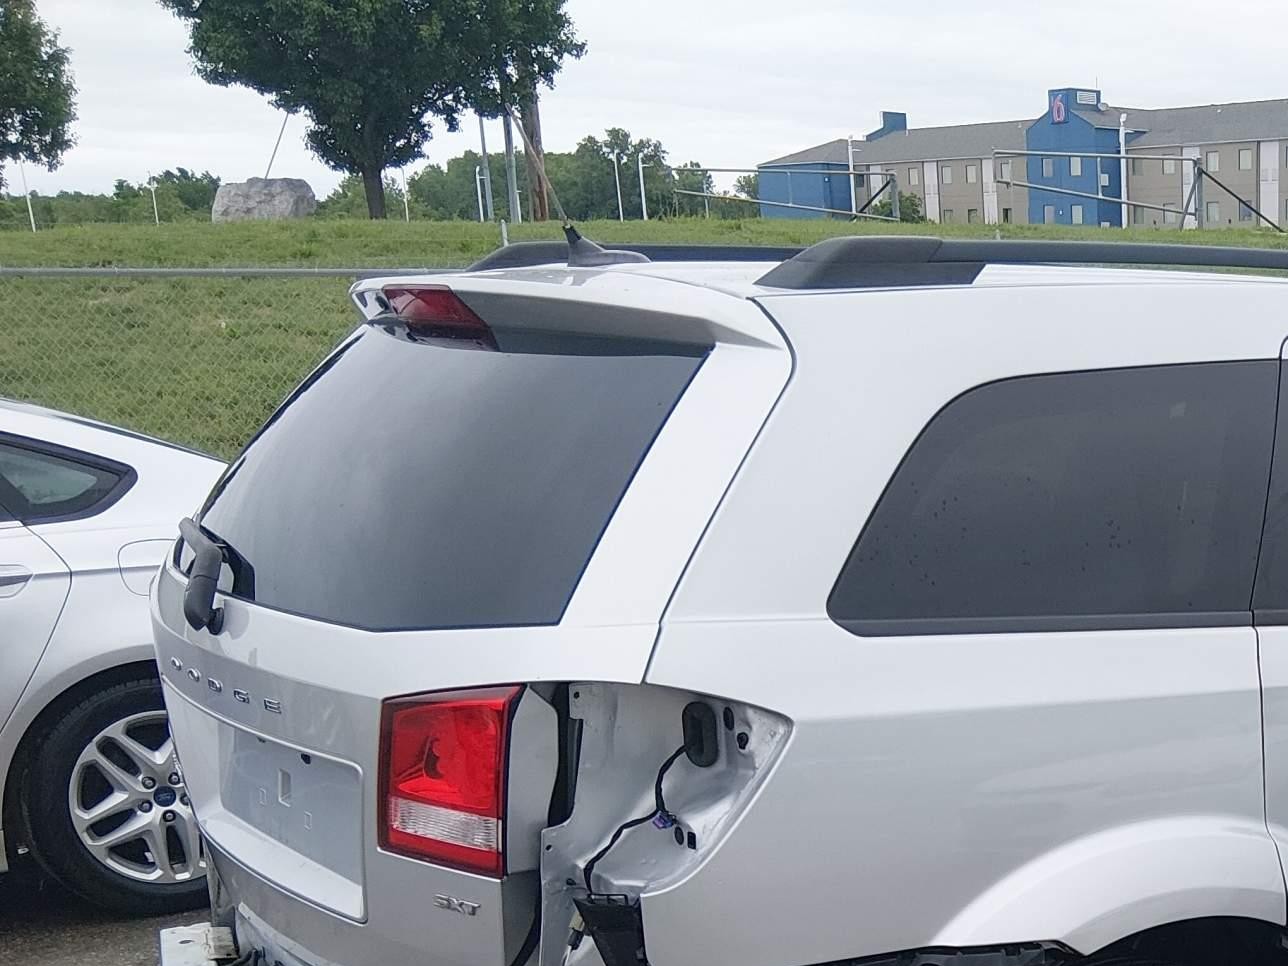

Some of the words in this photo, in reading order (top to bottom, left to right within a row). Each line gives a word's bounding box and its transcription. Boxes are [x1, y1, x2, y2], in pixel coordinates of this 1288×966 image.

[1053, 94, 1065, 122] 6
[170, 656, 282, 714] DODGE
[433, 893, 481, 916] SXT
